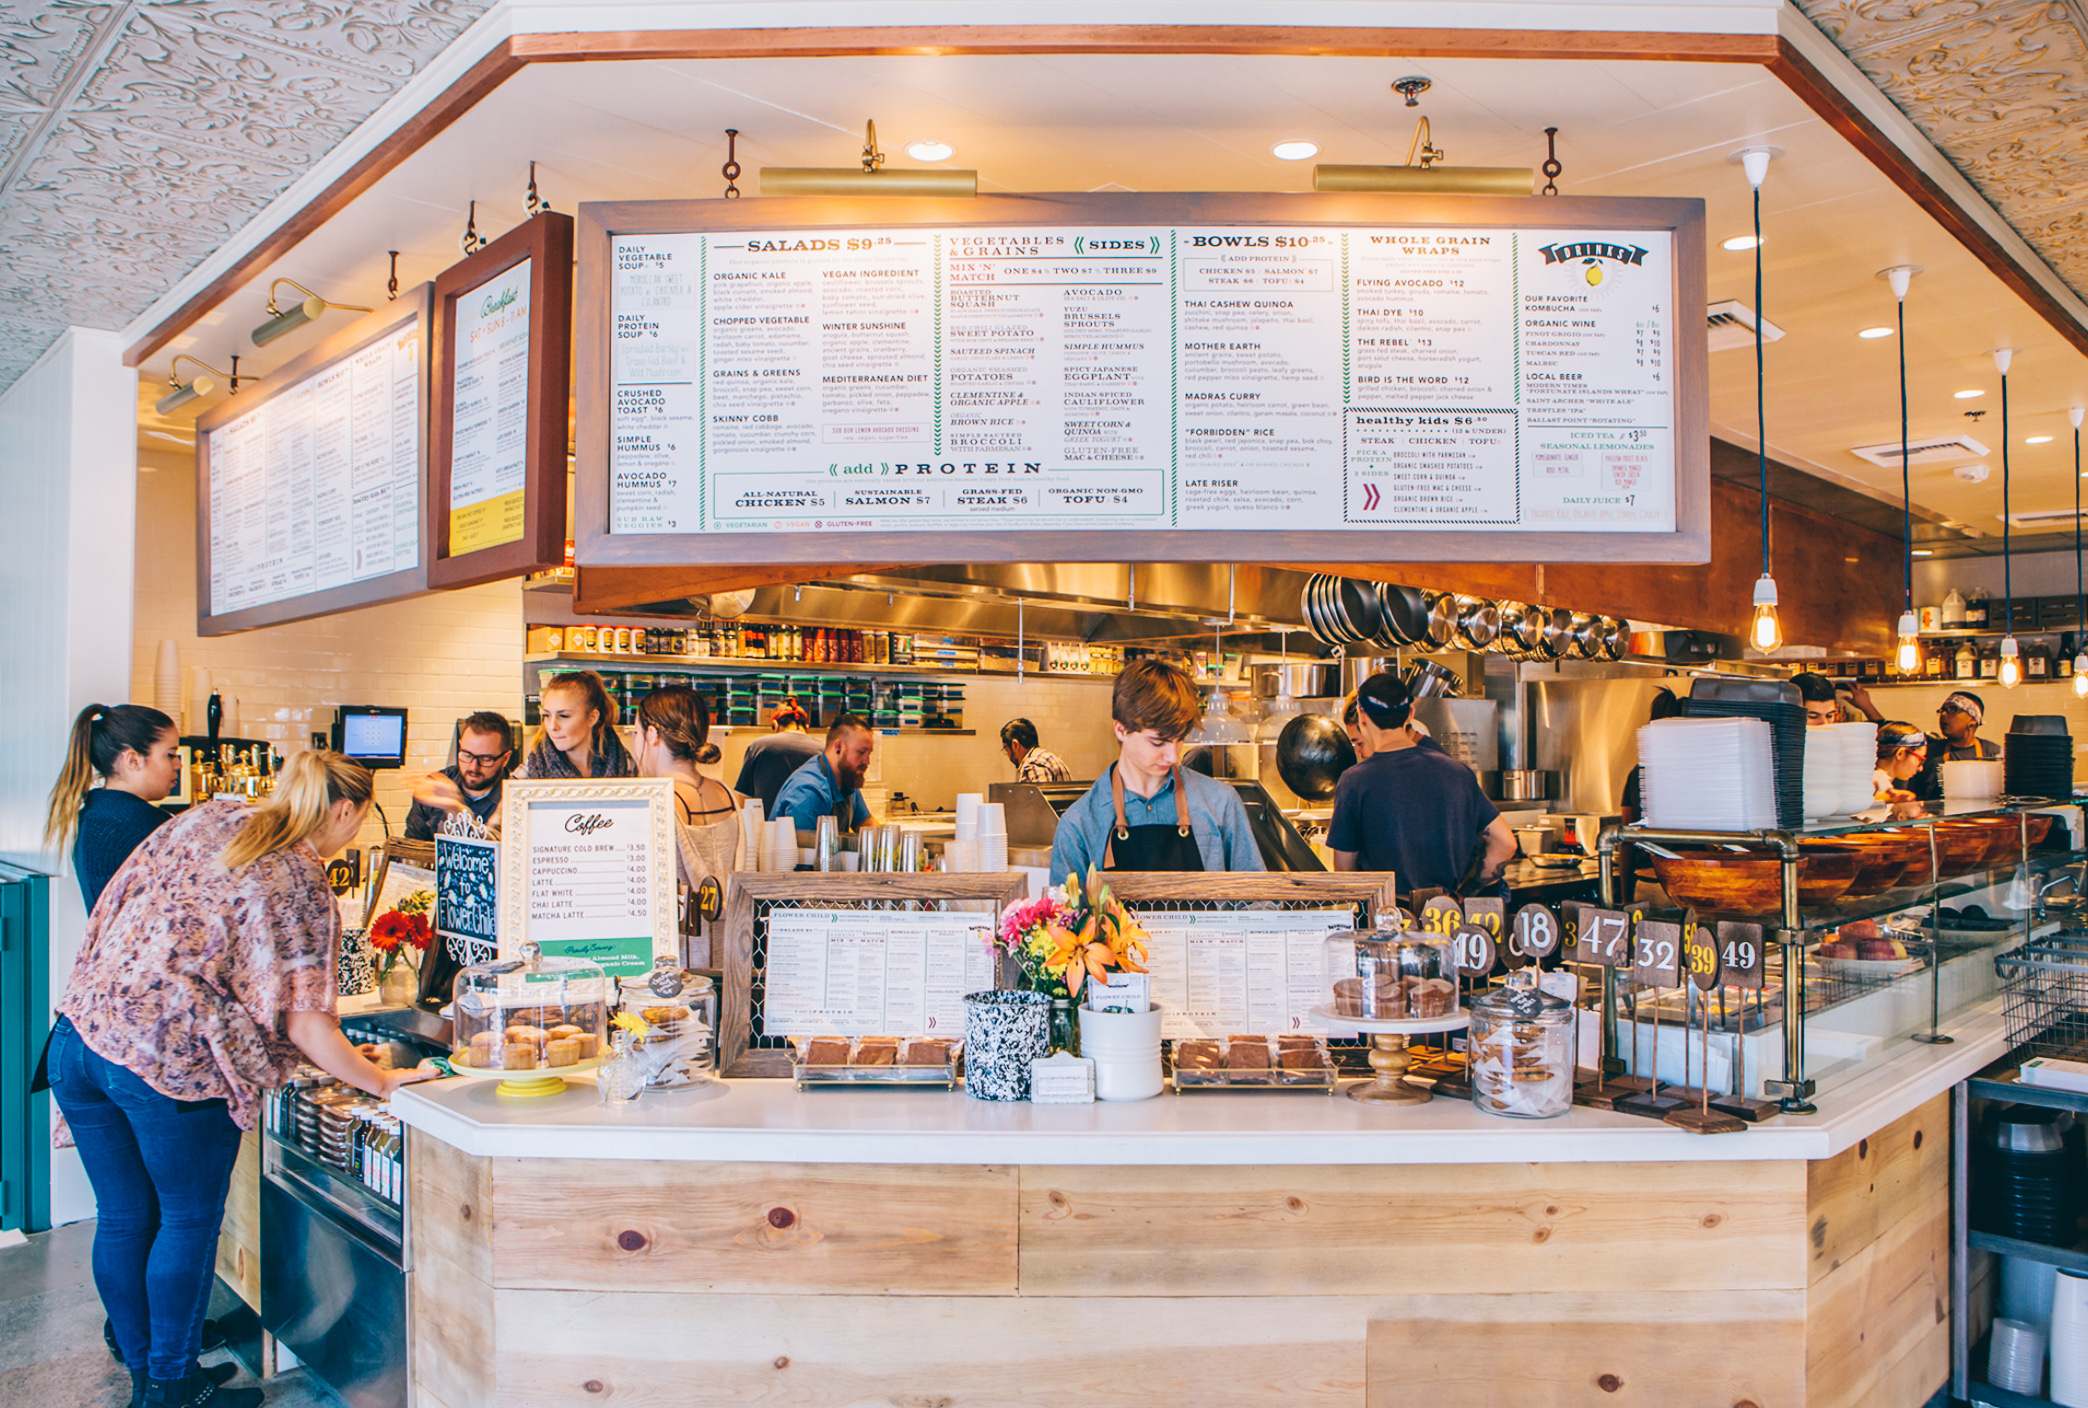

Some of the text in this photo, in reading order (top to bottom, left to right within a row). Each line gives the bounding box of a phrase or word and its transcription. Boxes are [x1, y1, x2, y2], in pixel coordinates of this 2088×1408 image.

[748, 240, 840, 252] SALADS
[951, 236, 1144, 249] VEGETABLES SIDES
[1193, 236, 1268, 247] BOWLS
[964, 247, 1038, 256] GRAINS
[1564, 244, 1624, 259] DRINKS
[619, 262, 643, 270] SOUP
[713, 316, 809, 325] CHOPPED VEGETABLE
[861, 322, 905, 330] SUNSHINE
[823, 375, 903, 383] MEDITERRANEAN
[1397, 376, 1413, 384] THE
[1357, 417, 1413, 426] healthy
[844, 463, 1041, 474] add PROTEIN
[736, 499, 805, 507] CHICKEN
[565, 814, 613, 835] Coffee
[444, 843, 489, 874] Welcome
[328, 867, 350, 887] 42
[460, 876, 471, 896] to
[701, 886, 717, 911] 27
[1425, 907, 1461, 937] 36
[1521, 912, 1550, 948] 18
[1581, 916, 1625, 956] 47
[1638, 939, 1675, 970] 32
[1691, 944, 1715, 974] 39
[1722, 941, 1756, 969] 49
